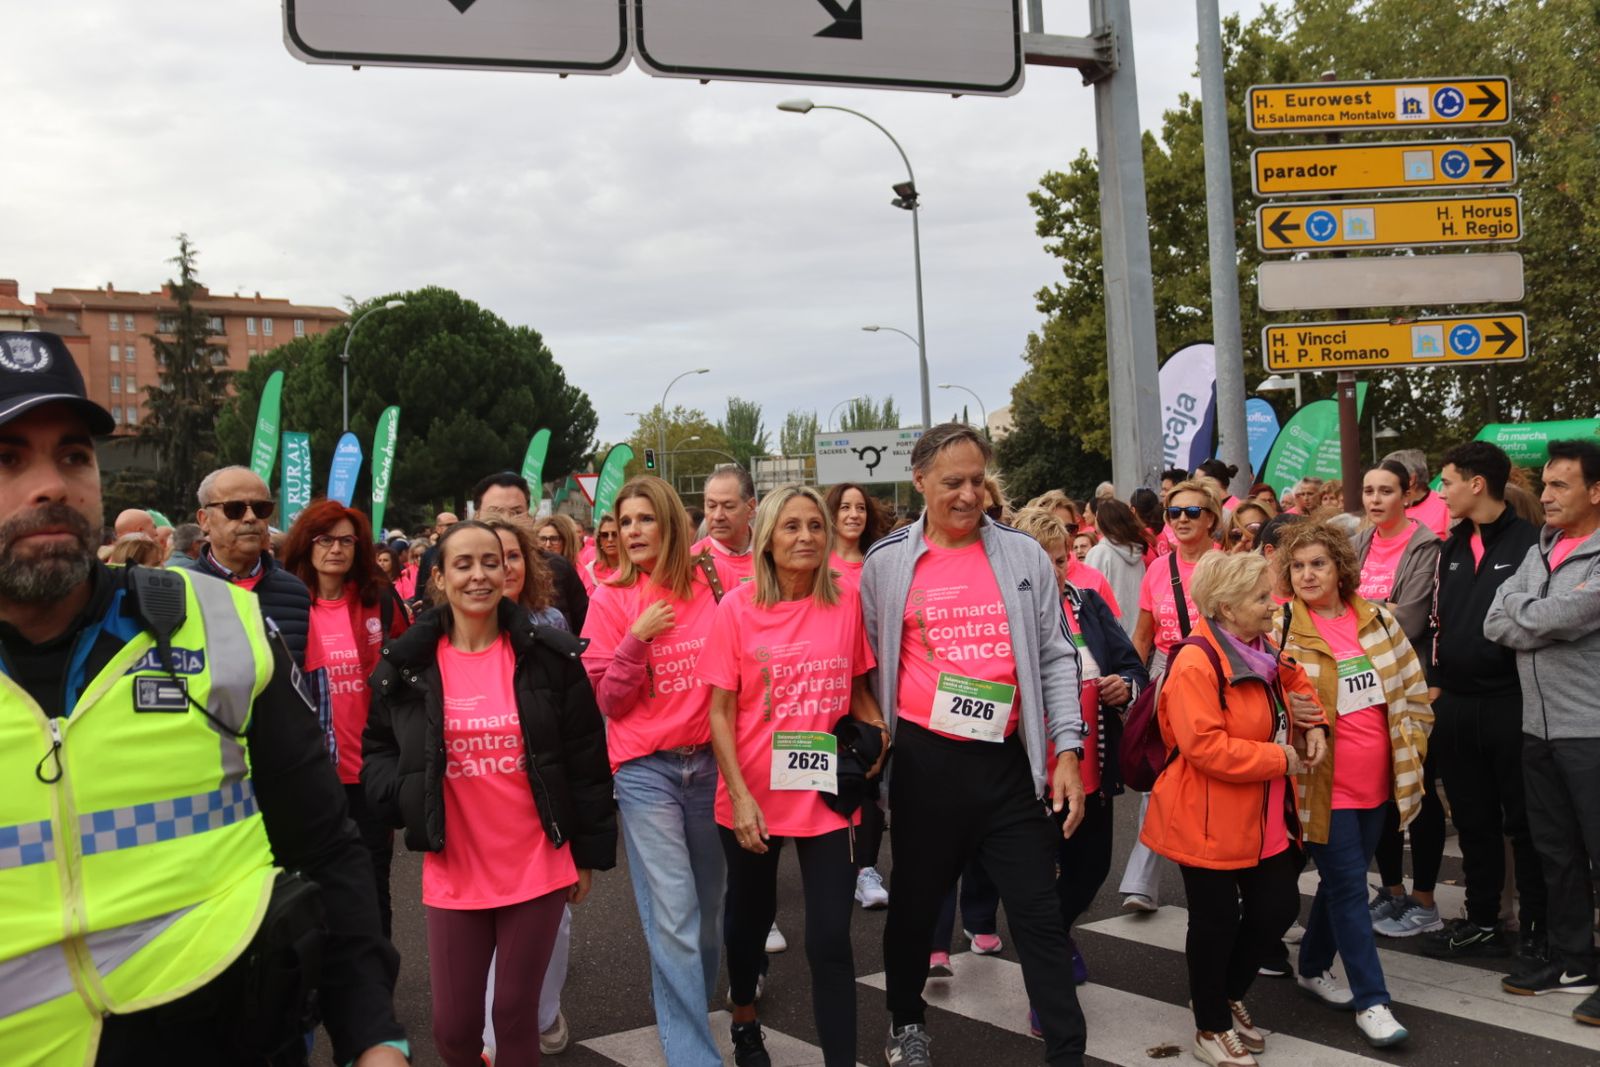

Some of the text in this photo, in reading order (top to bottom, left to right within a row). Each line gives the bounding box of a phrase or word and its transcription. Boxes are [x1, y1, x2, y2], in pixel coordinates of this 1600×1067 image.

[1256, 91, 1372, 108] H. Eurowest
[1340, 110, 1396, 121] Montalvo
[1263, 163, 1337, 182] parador
[1437, 205, 1513, 221] H. Horus
[1442, 219, 1513, 237] H. Regio
[1273, 330, 1347, 347] H. Vincci
[1273, 347, 1389, 363] H. P. Romano
[1163, 392, 1197, 466] icaja
[1497, 431, 1547, 441] En marcha
[925, 600, 1007, 621] En march
[928, 621, 1011, 640] contra e
[330, 649, 359, 660] mar
[651, 636, 707, 657] En mar
[934, 640, 1011, 661] cánce
[655, 653, 696, 676] cont
[772, 654, 848, 679] En marcha
[658, 672, 702, 694] cán
[774, 676, 834, 699] contra
[1345, 672, 1377, 693] 7172
[774, 695, 848, 719] cáncer
[950, 696, 995, 720] 2626
[467, 712, 520, 731] marc
[445, 752, 527, 779] cánce
[788, 752, 829, 771] 2625
